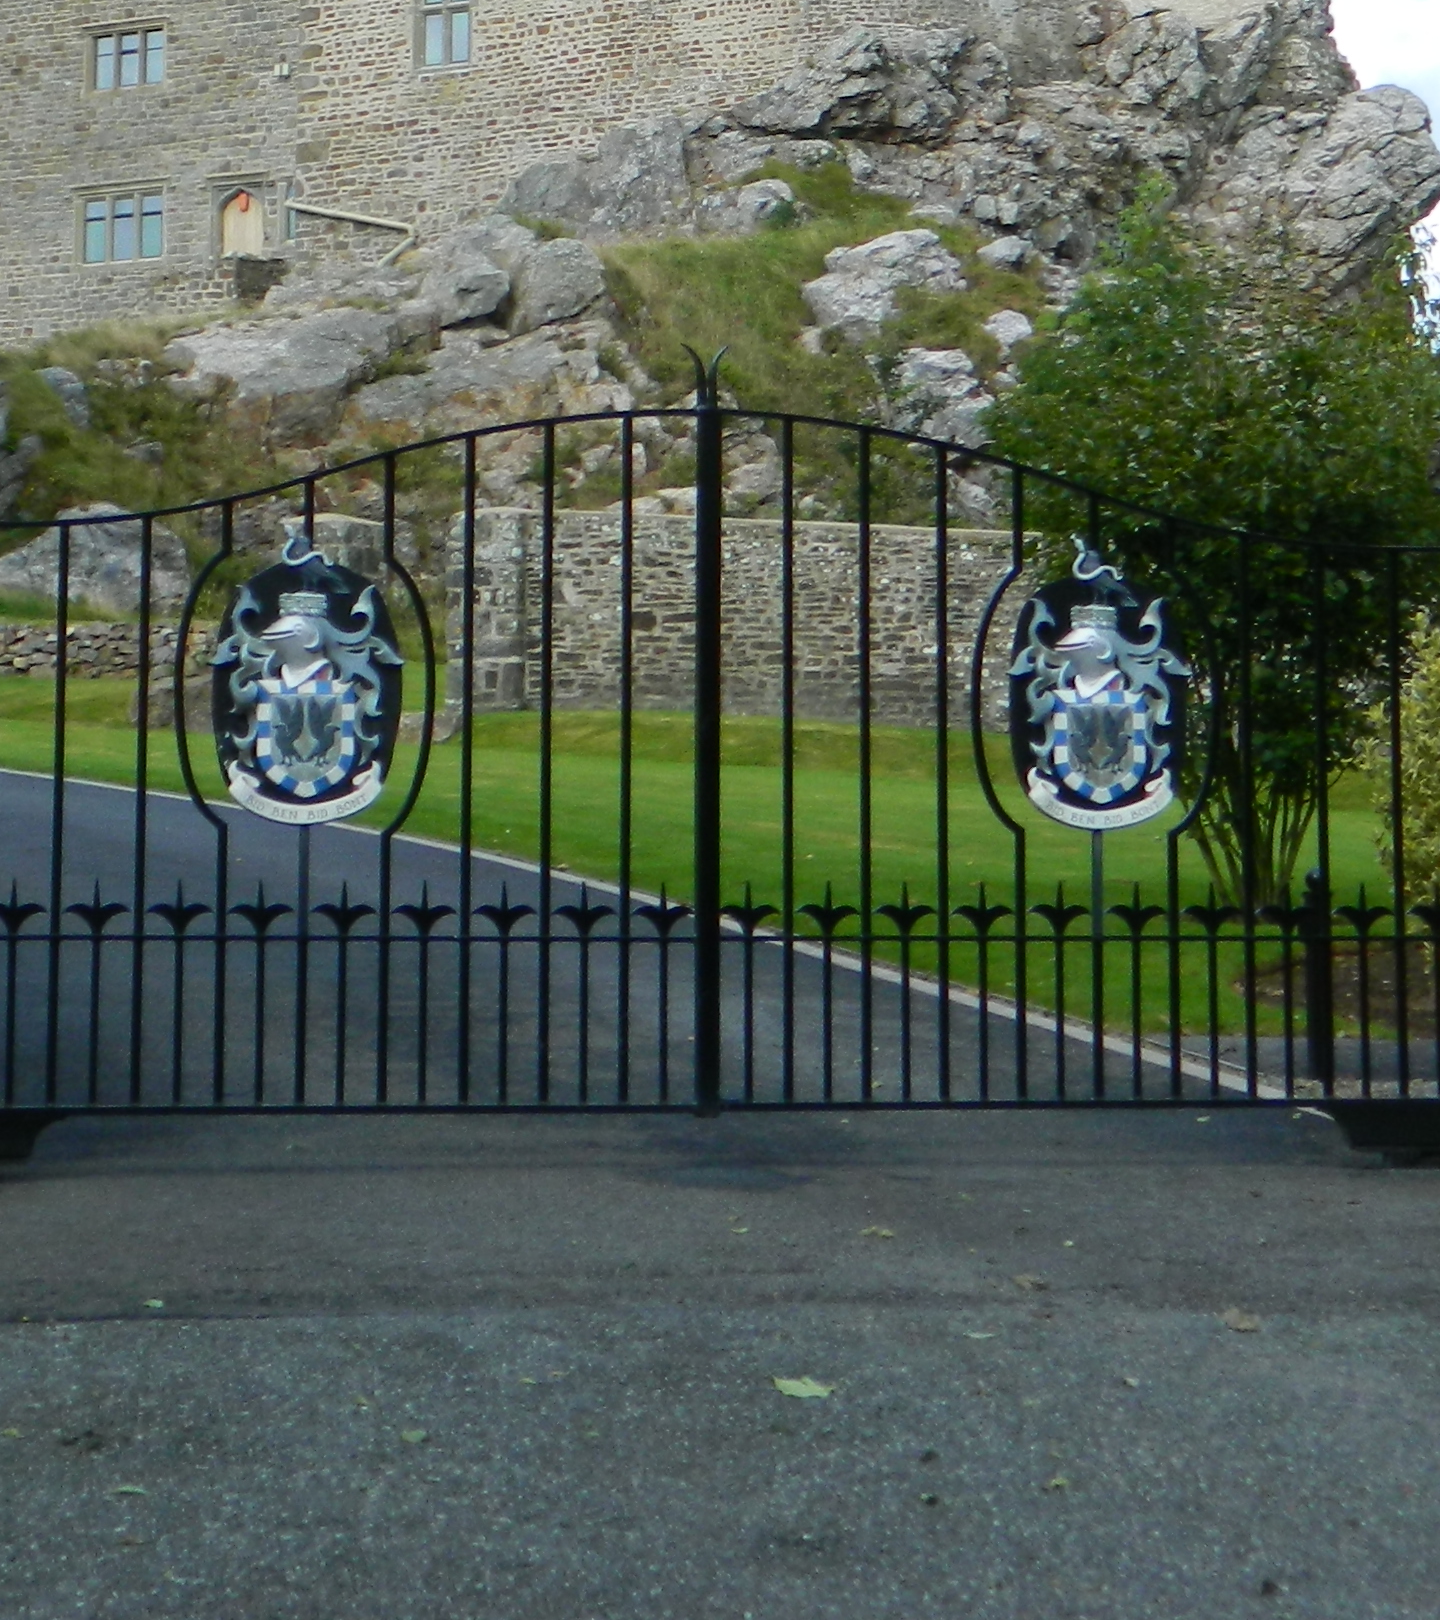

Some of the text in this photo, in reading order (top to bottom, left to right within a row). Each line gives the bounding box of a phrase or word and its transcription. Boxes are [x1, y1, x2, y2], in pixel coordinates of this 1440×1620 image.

[246, 794, 368, 820] BID BEN BID BONT
